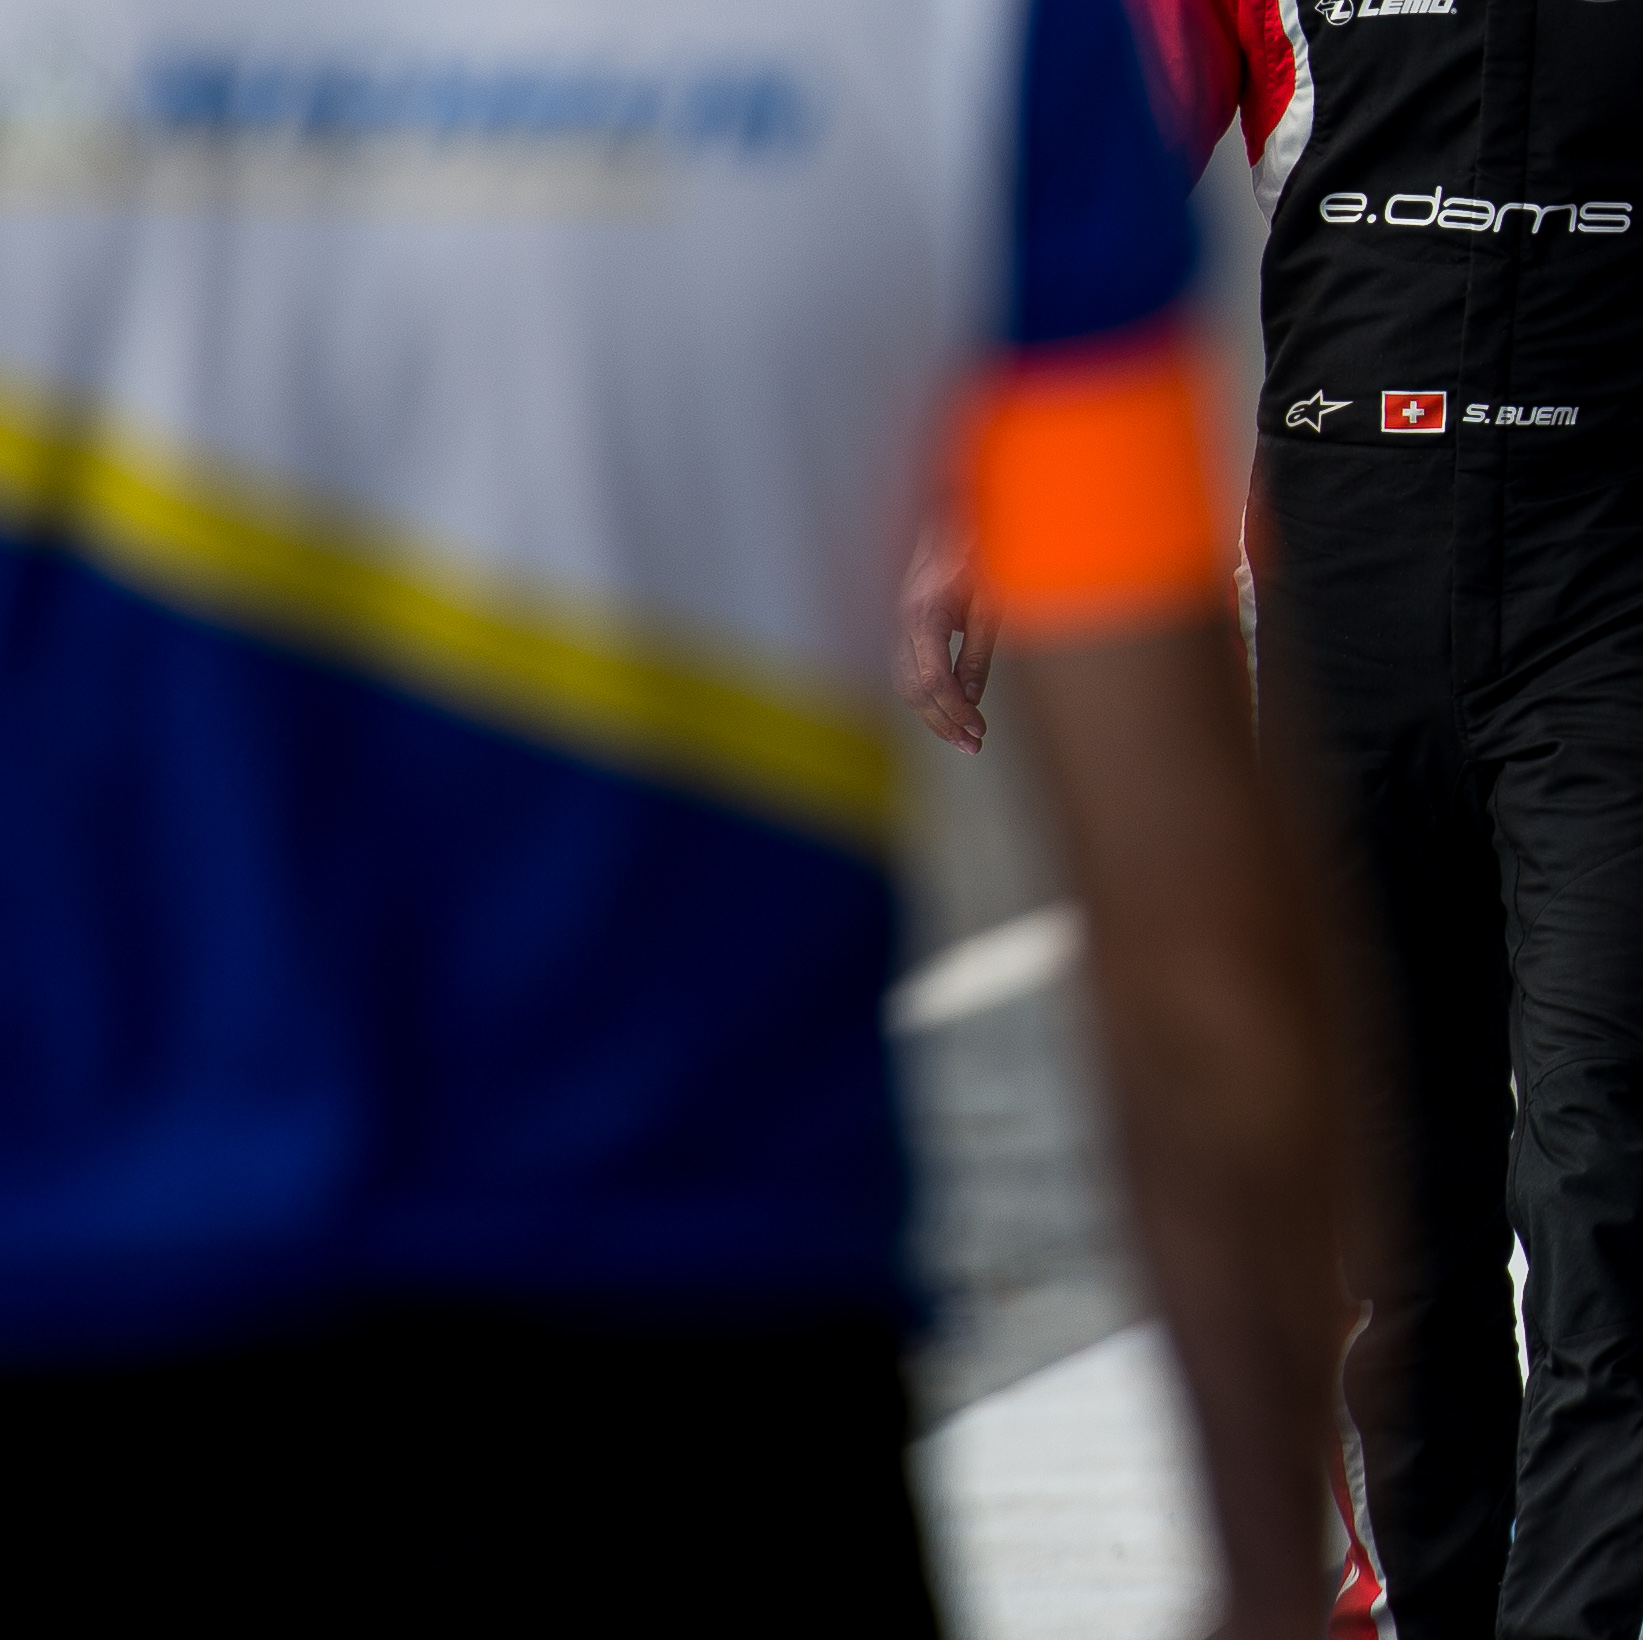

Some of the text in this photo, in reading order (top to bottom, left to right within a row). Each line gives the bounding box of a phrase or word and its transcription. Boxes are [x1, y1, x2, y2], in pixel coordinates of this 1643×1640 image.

[1319, 185, 1633, 234] e.dams
[1462, 403, 1580, 426] S. BUEMI
